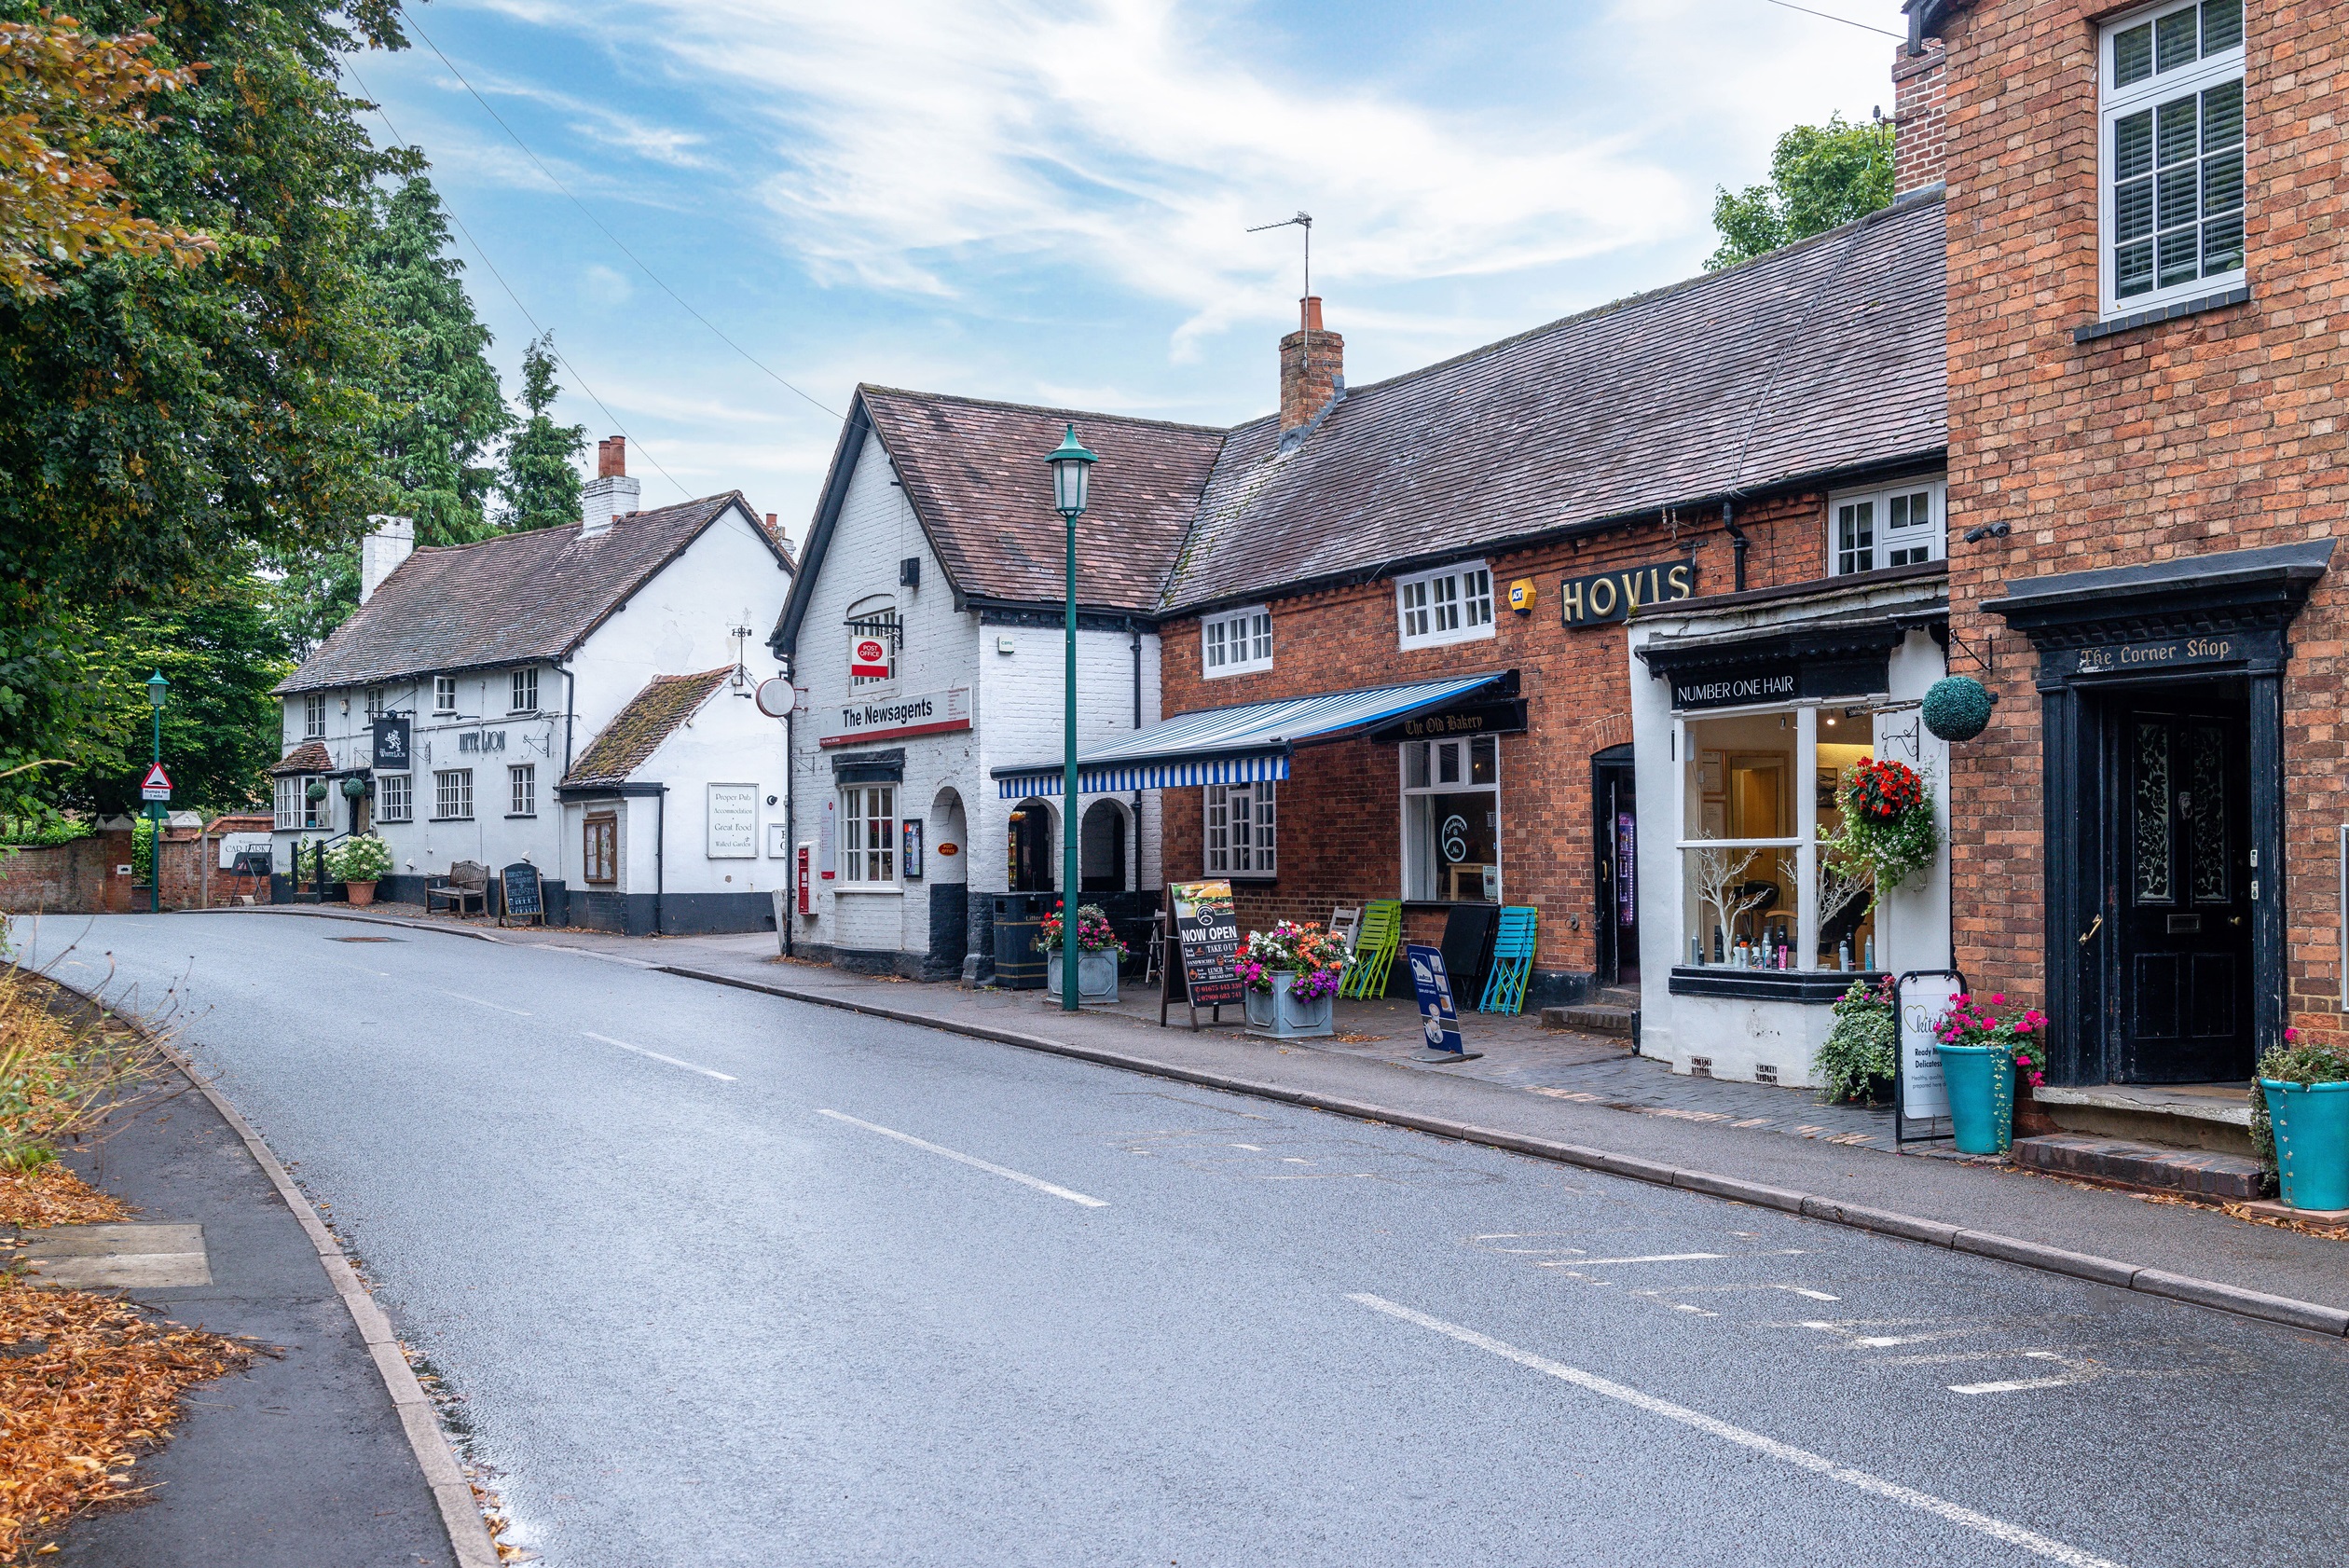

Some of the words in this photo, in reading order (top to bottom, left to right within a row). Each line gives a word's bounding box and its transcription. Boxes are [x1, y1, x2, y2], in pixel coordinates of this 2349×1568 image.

[1513, 589, 1522, 599] ADT
[1563, 565, 1690, 622] HOVIS
[2081, 649, 2112, 667] The
[2121, 646, 2177, 664] Corner
[2187, 639, 2230, 660] Shop
[1678, 682, 1731, 702] NUMBER
[1733, 679, 1761, 696] ONE
[1764, 676, 1793, 694] HAIR
[843, 708, 861, 727] The
[865, 697, 933, 724] Newsagents
[1405, 720, 1423, 736] The
[1426, 717, 1444, 733] Old
[1447, 714, 1483, 733] Bakery
[481, 730, 506, 752] LION
[716, 793, 737, 802] Proper
[225, 845, 242, 853] CAR
[509, 903, 541, 914] GARDEN
[1181, 928, 1206, 942] NOW
[1209, 926, 1238, 941] OPEN
[1206, 943, 1223, 953] TAKE
[1223, 942, 1238, 952] OUT
[1915, 1048, 1931, 1057] Ready
[1916, 1059, 1942, 1068] Delicatess
